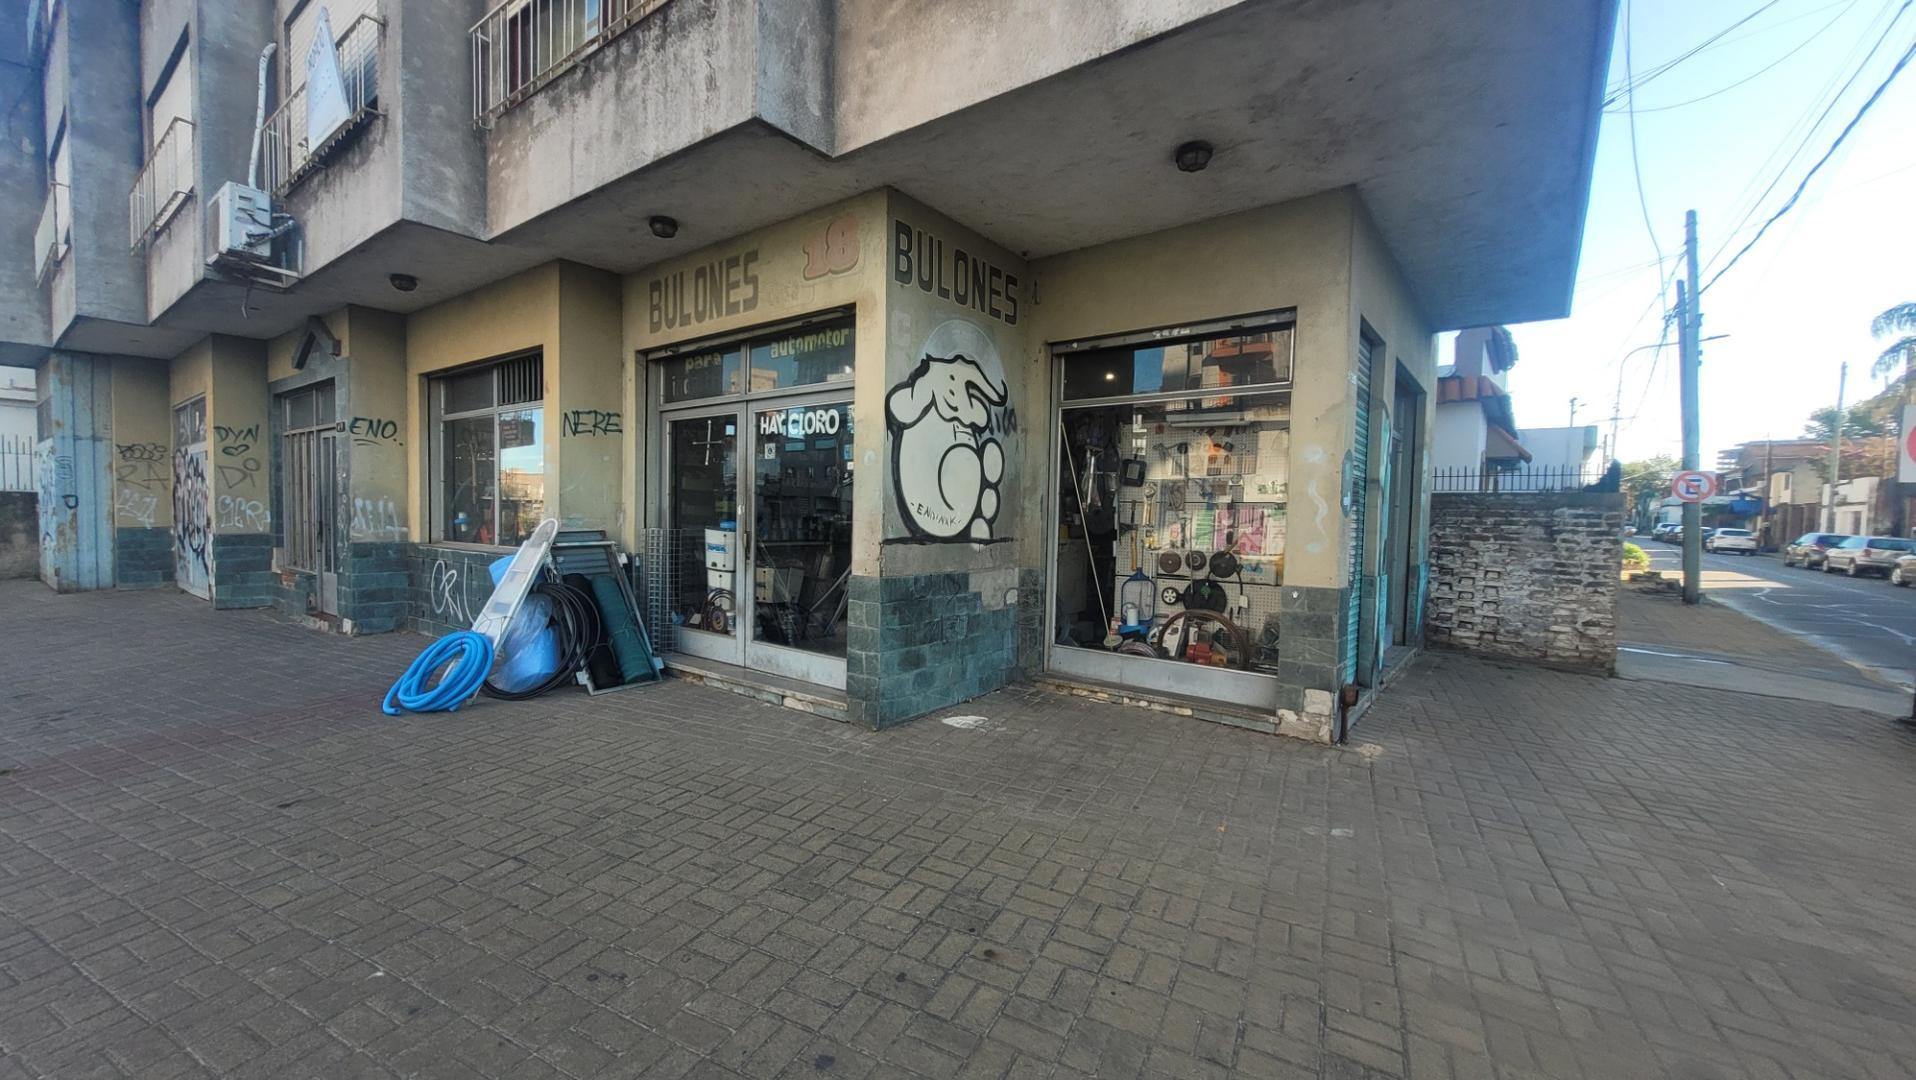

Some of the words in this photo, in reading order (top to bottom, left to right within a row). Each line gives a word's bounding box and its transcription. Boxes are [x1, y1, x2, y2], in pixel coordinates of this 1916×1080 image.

[649, 249, 759, 335] BULONES
[802, 215, 860, 281] 18
[894, 219, 1018, 326] BULONES
[770, 328, 850, 359] automotor
[562, 409, 623, 437] NERE
[760, 415, 785, 435] HAY
[787, 408, 840, 435] CLORO
